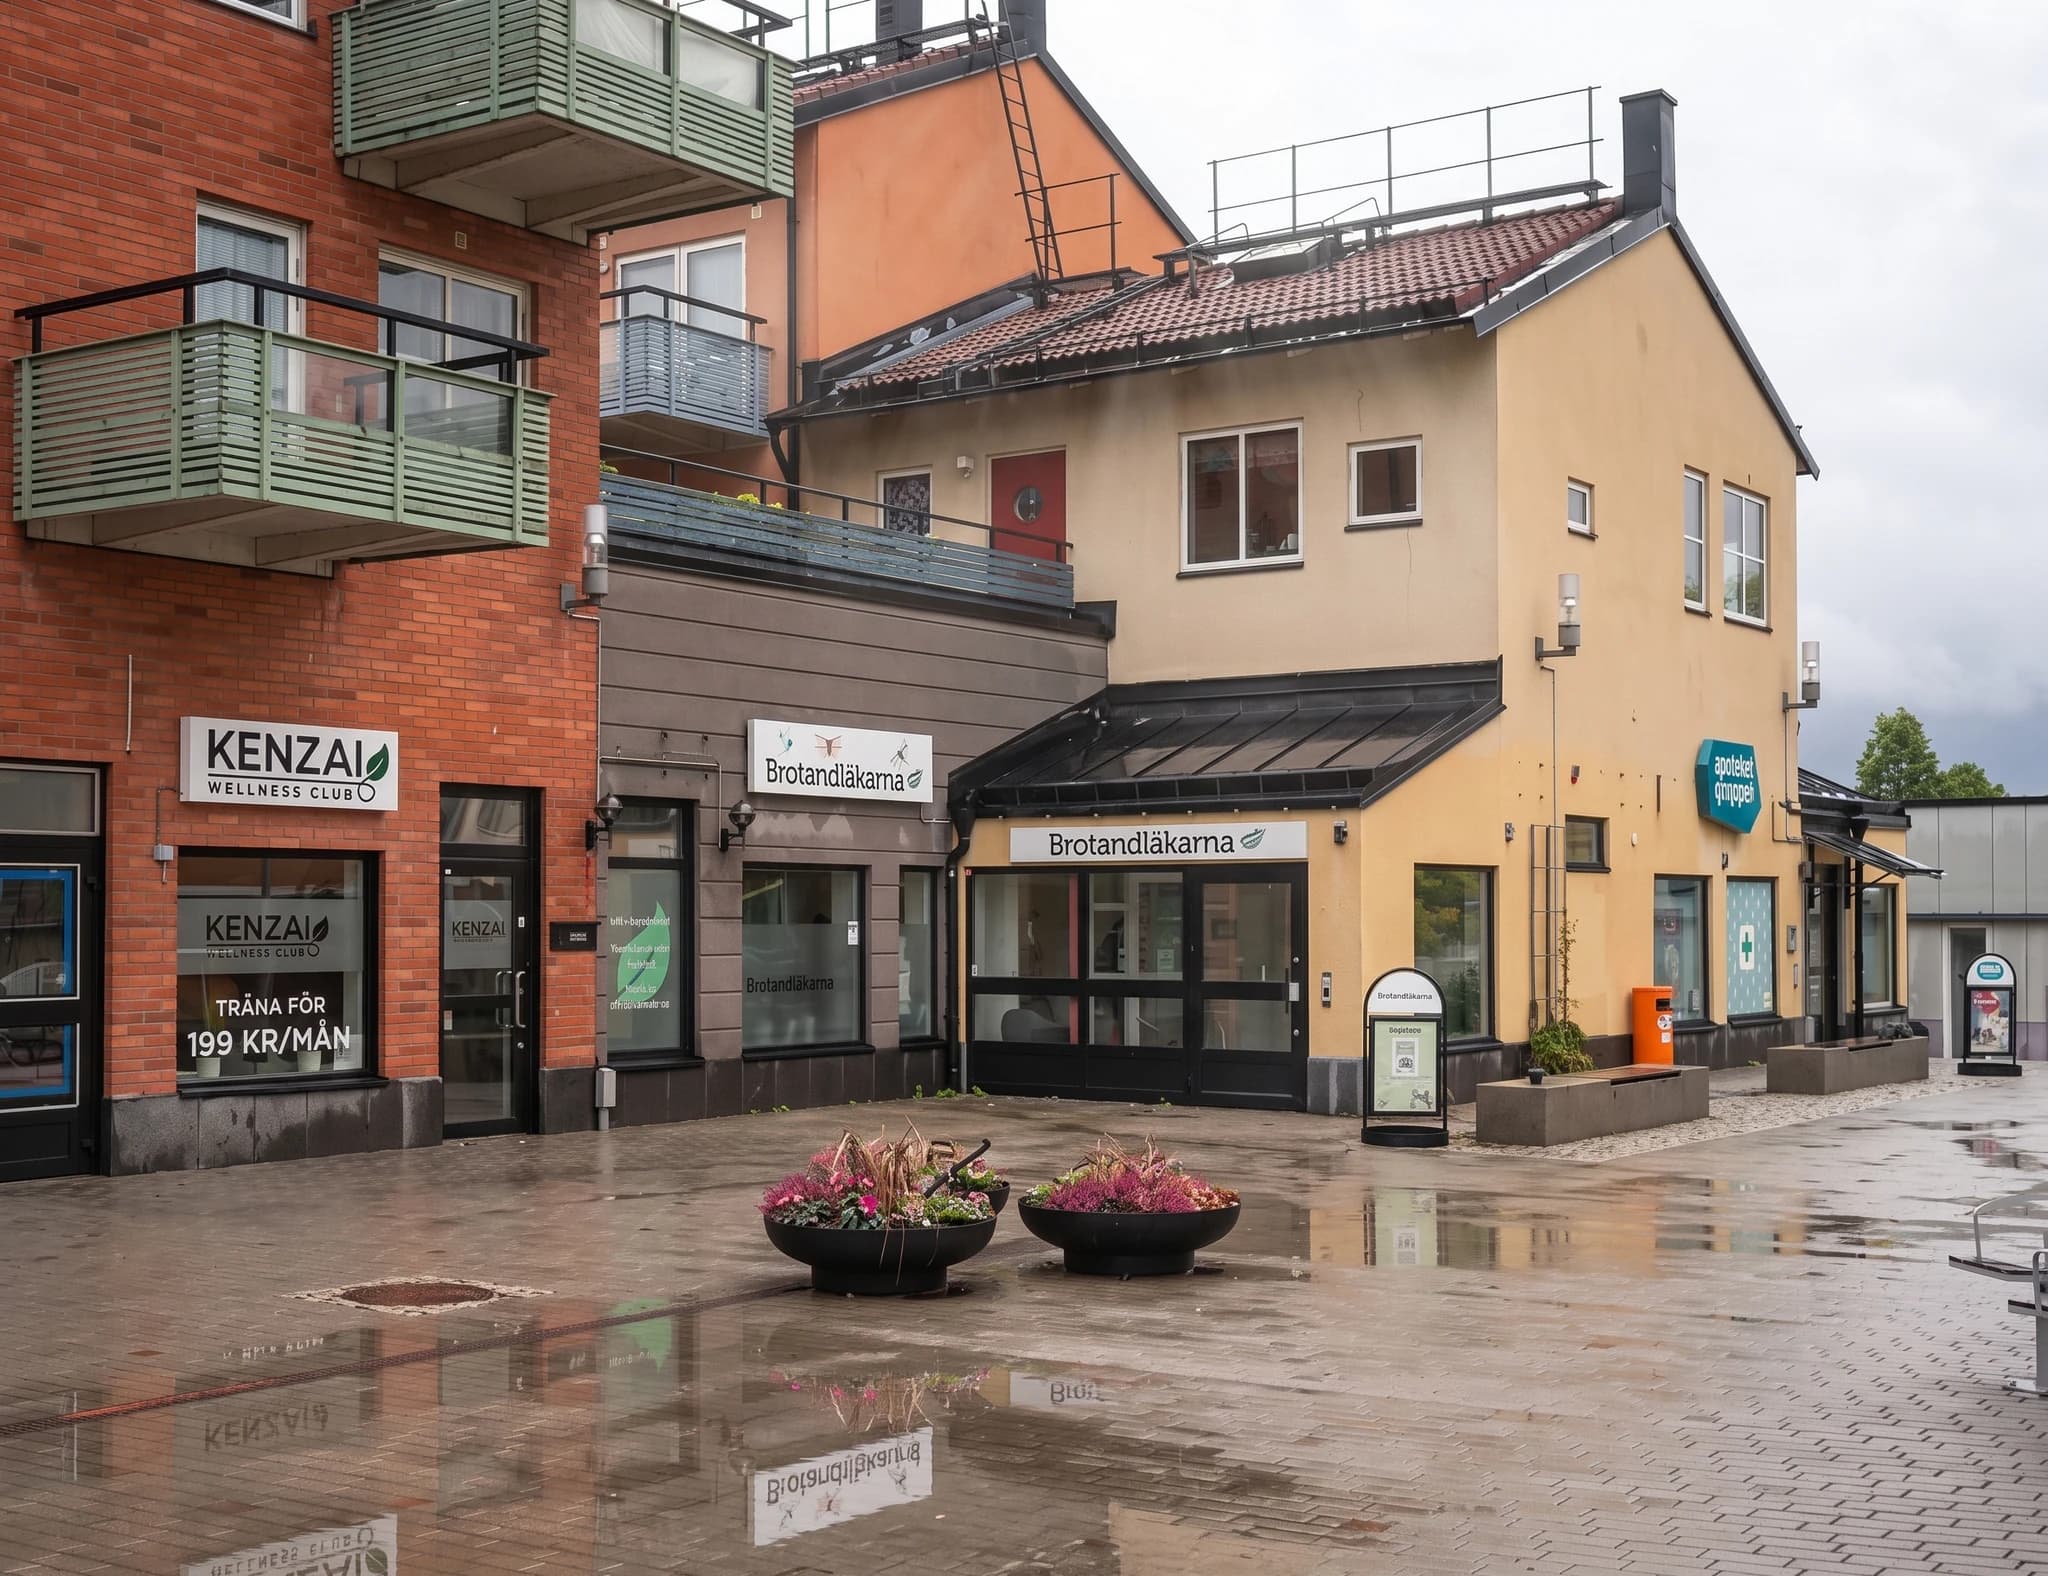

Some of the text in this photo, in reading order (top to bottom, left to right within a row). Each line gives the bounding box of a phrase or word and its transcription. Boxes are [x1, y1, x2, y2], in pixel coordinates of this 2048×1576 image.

[207, 729, 362, 778] KENZAI
[765, 757, 905, 792] Brotandläkarna
[207, 781, 353, 801] WELLNESS CLUB
[1049, 830, 1235, 856] Brotandläkarna
[206, 914, 310, 941] KENZAI
[452, 920, 506, 937] KENZAI
[206, 947, 305, 959] WELLNESS CLUB
[746, 975, 834, 993] Brotandläkarna
[215, 991, 326, 1017] TRÄNA FÖR
[187, 1018, 350, 1058] 199 KR/MÅN
